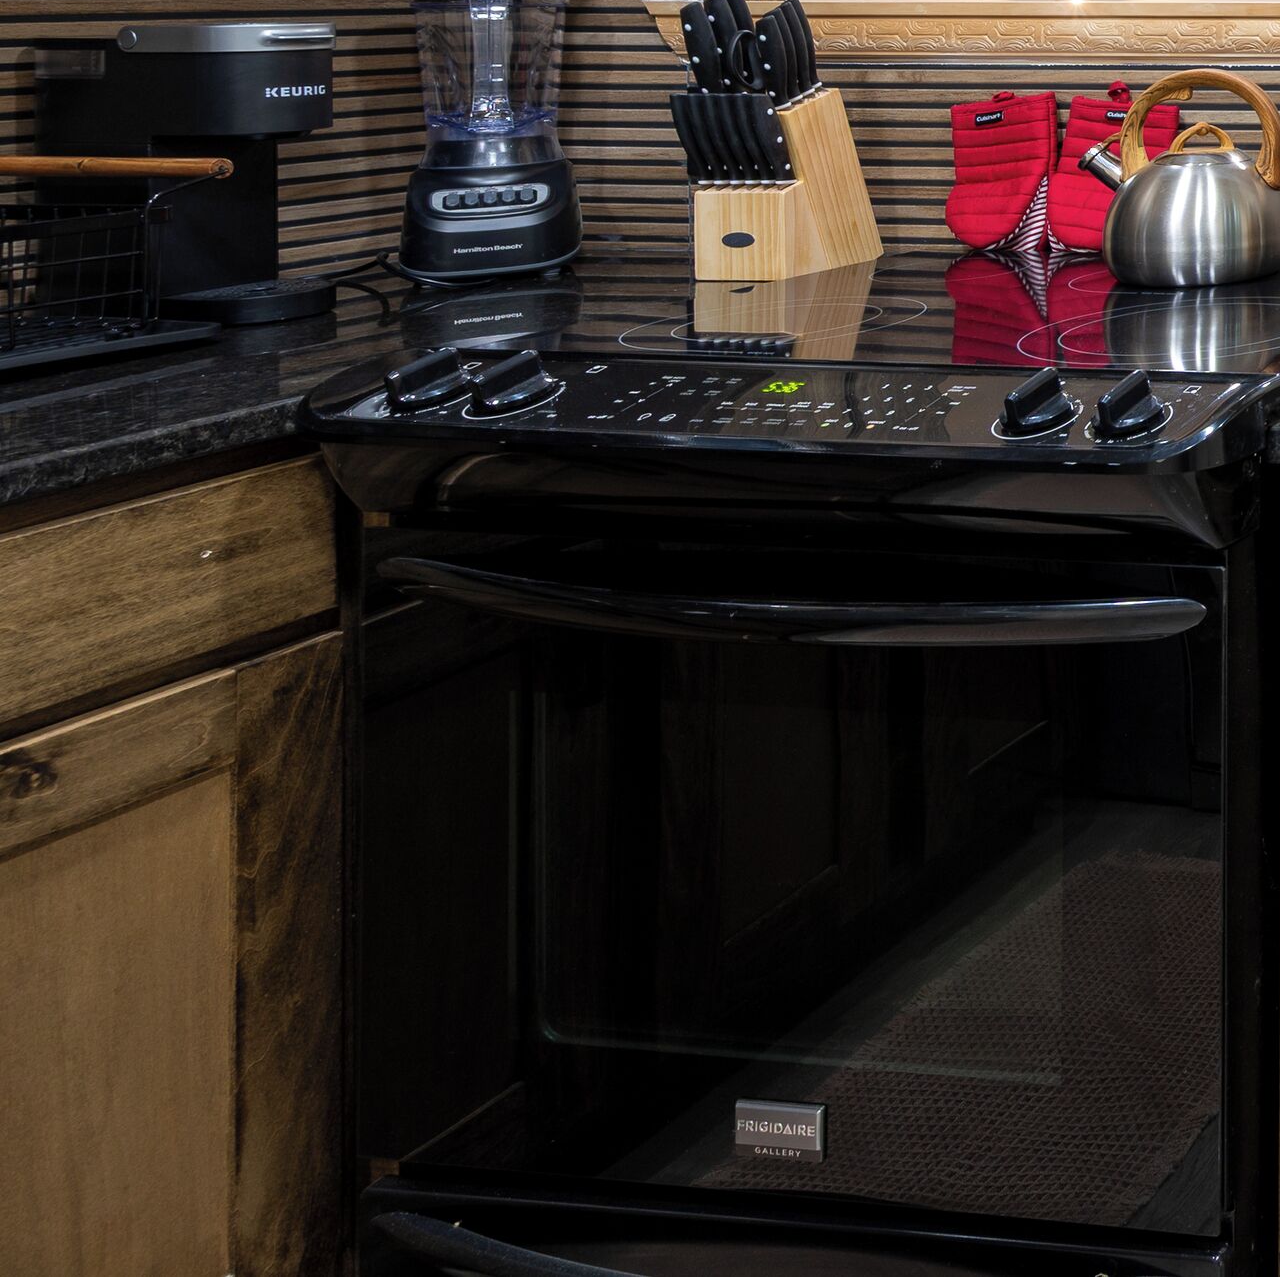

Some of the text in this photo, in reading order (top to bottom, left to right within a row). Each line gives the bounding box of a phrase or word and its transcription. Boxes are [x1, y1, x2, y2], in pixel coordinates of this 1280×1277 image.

[264, 84, 326, 98] KEURIG
[453, 243, 523, 254] Hamilton Beach
[737, 1119, 816, 1137] FRIGIDAIRE
[754, 1146, 802, 1158] GALLERY
